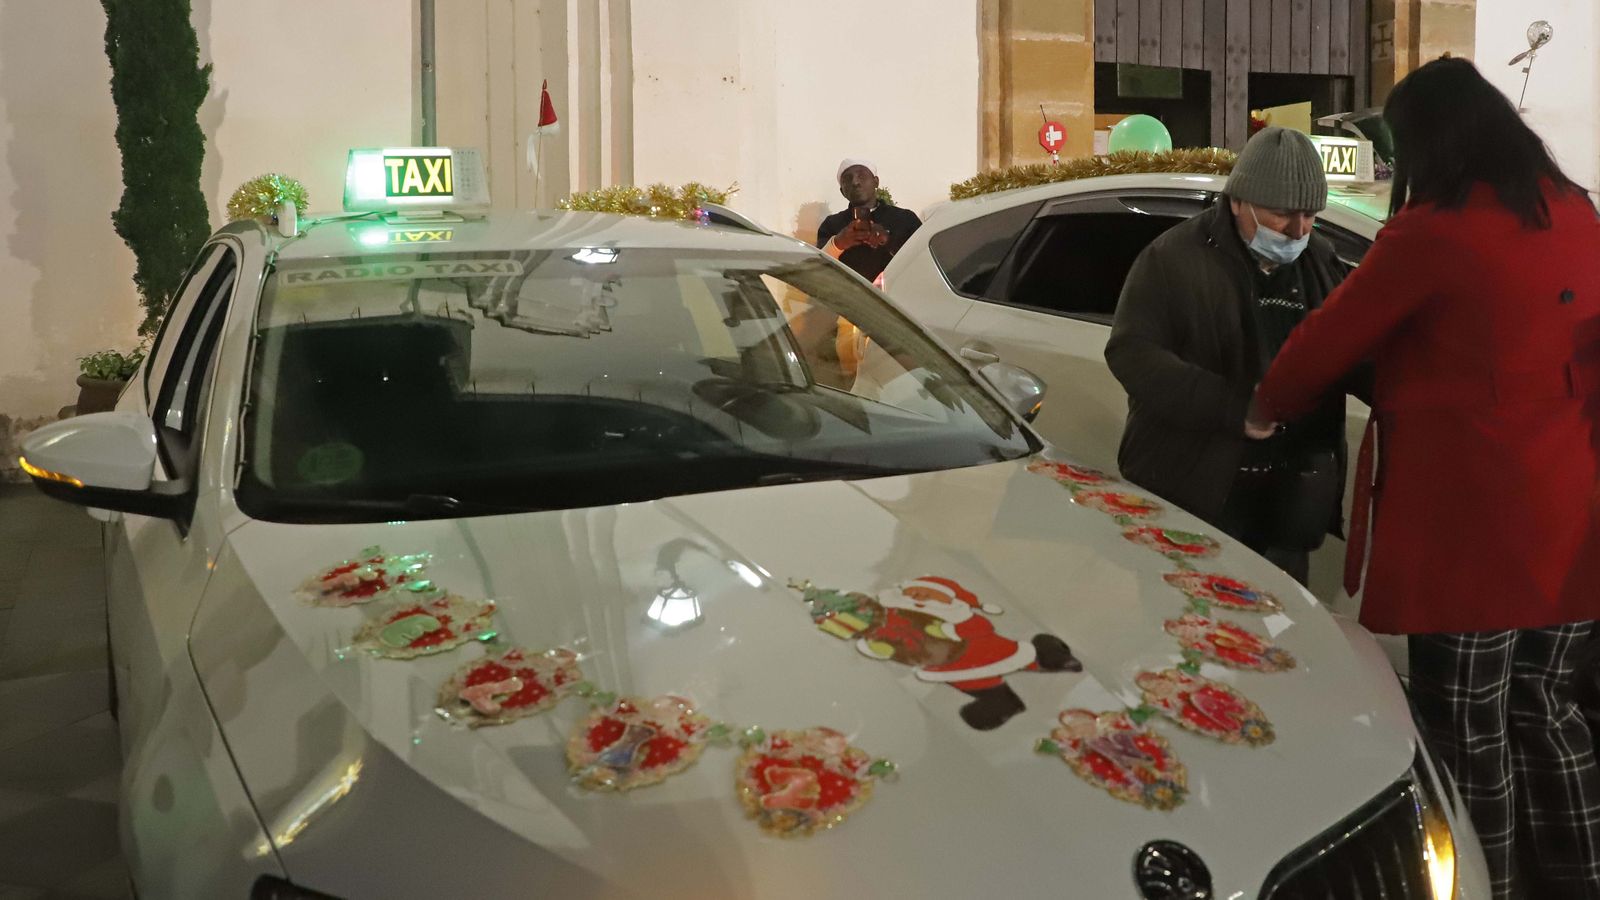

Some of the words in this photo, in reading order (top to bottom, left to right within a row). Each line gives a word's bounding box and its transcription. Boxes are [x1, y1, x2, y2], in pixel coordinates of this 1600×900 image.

[1321, 146, 1357, 173] TAXI
[384, 158, 452, 194] TAXI
[287, 265, 415, 284] RADIO
[425, 262, 516, 275] TAXI
